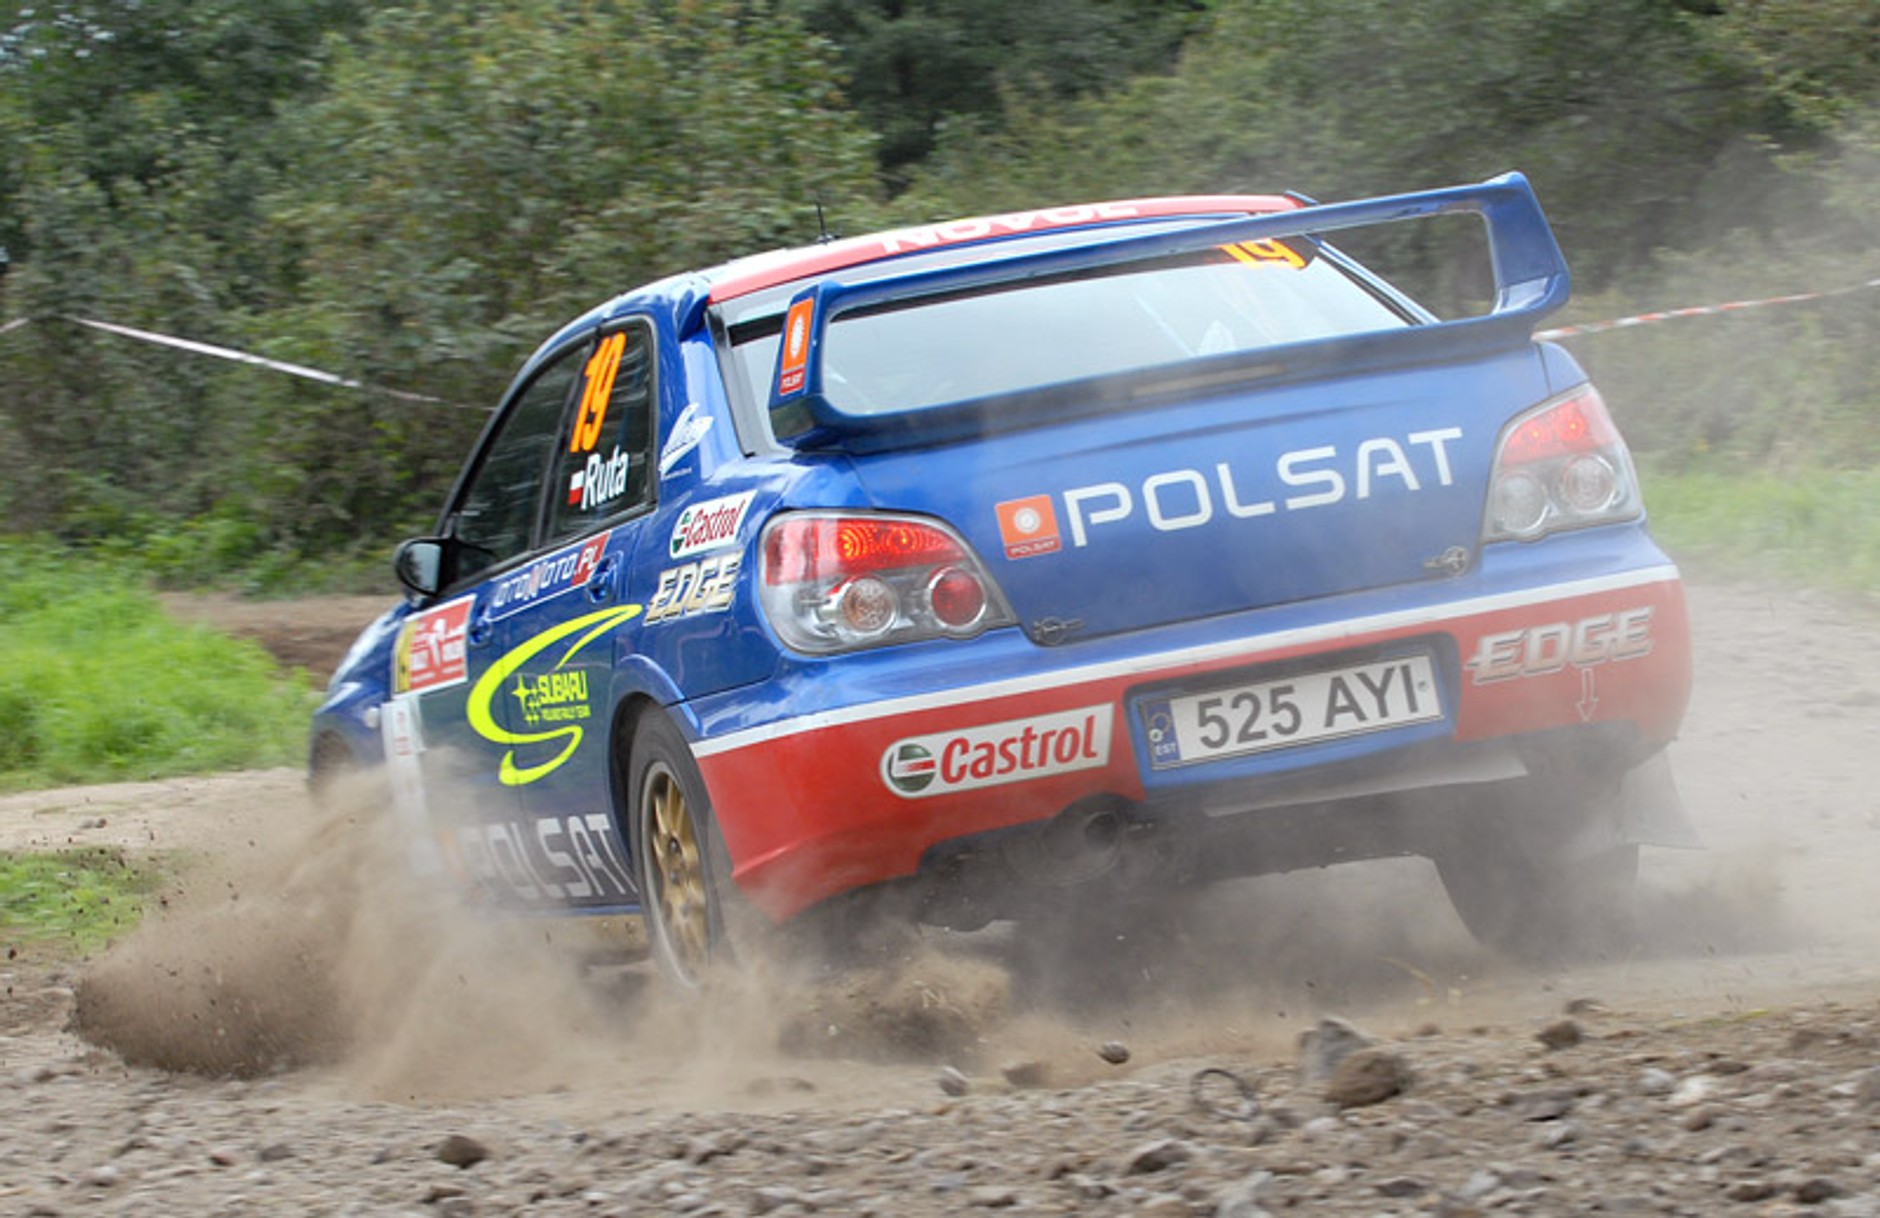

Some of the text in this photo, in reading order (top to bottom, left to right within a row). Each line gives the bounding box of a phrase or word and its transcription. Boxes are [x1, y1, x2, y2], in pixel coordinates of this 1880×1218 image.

[881, 203, 1138, 254] NOVOL
[569, 331, 627, 453] 19
[580, 444, 629, 511] Ruta
[1062, 427, 1463, 547] POLSAT
[685, 499, 746, 548] Castrol
[642, 550, 744, 626] EDGE
[1464, 605, 1655, 685] EDGE
[538, 669, 589, 705] SUBARU
[1198, 665, 1419, 749] 525 AYI
[940, 714, 1098, 785] Castrol
[1155, 742, 1178, 756] EST
